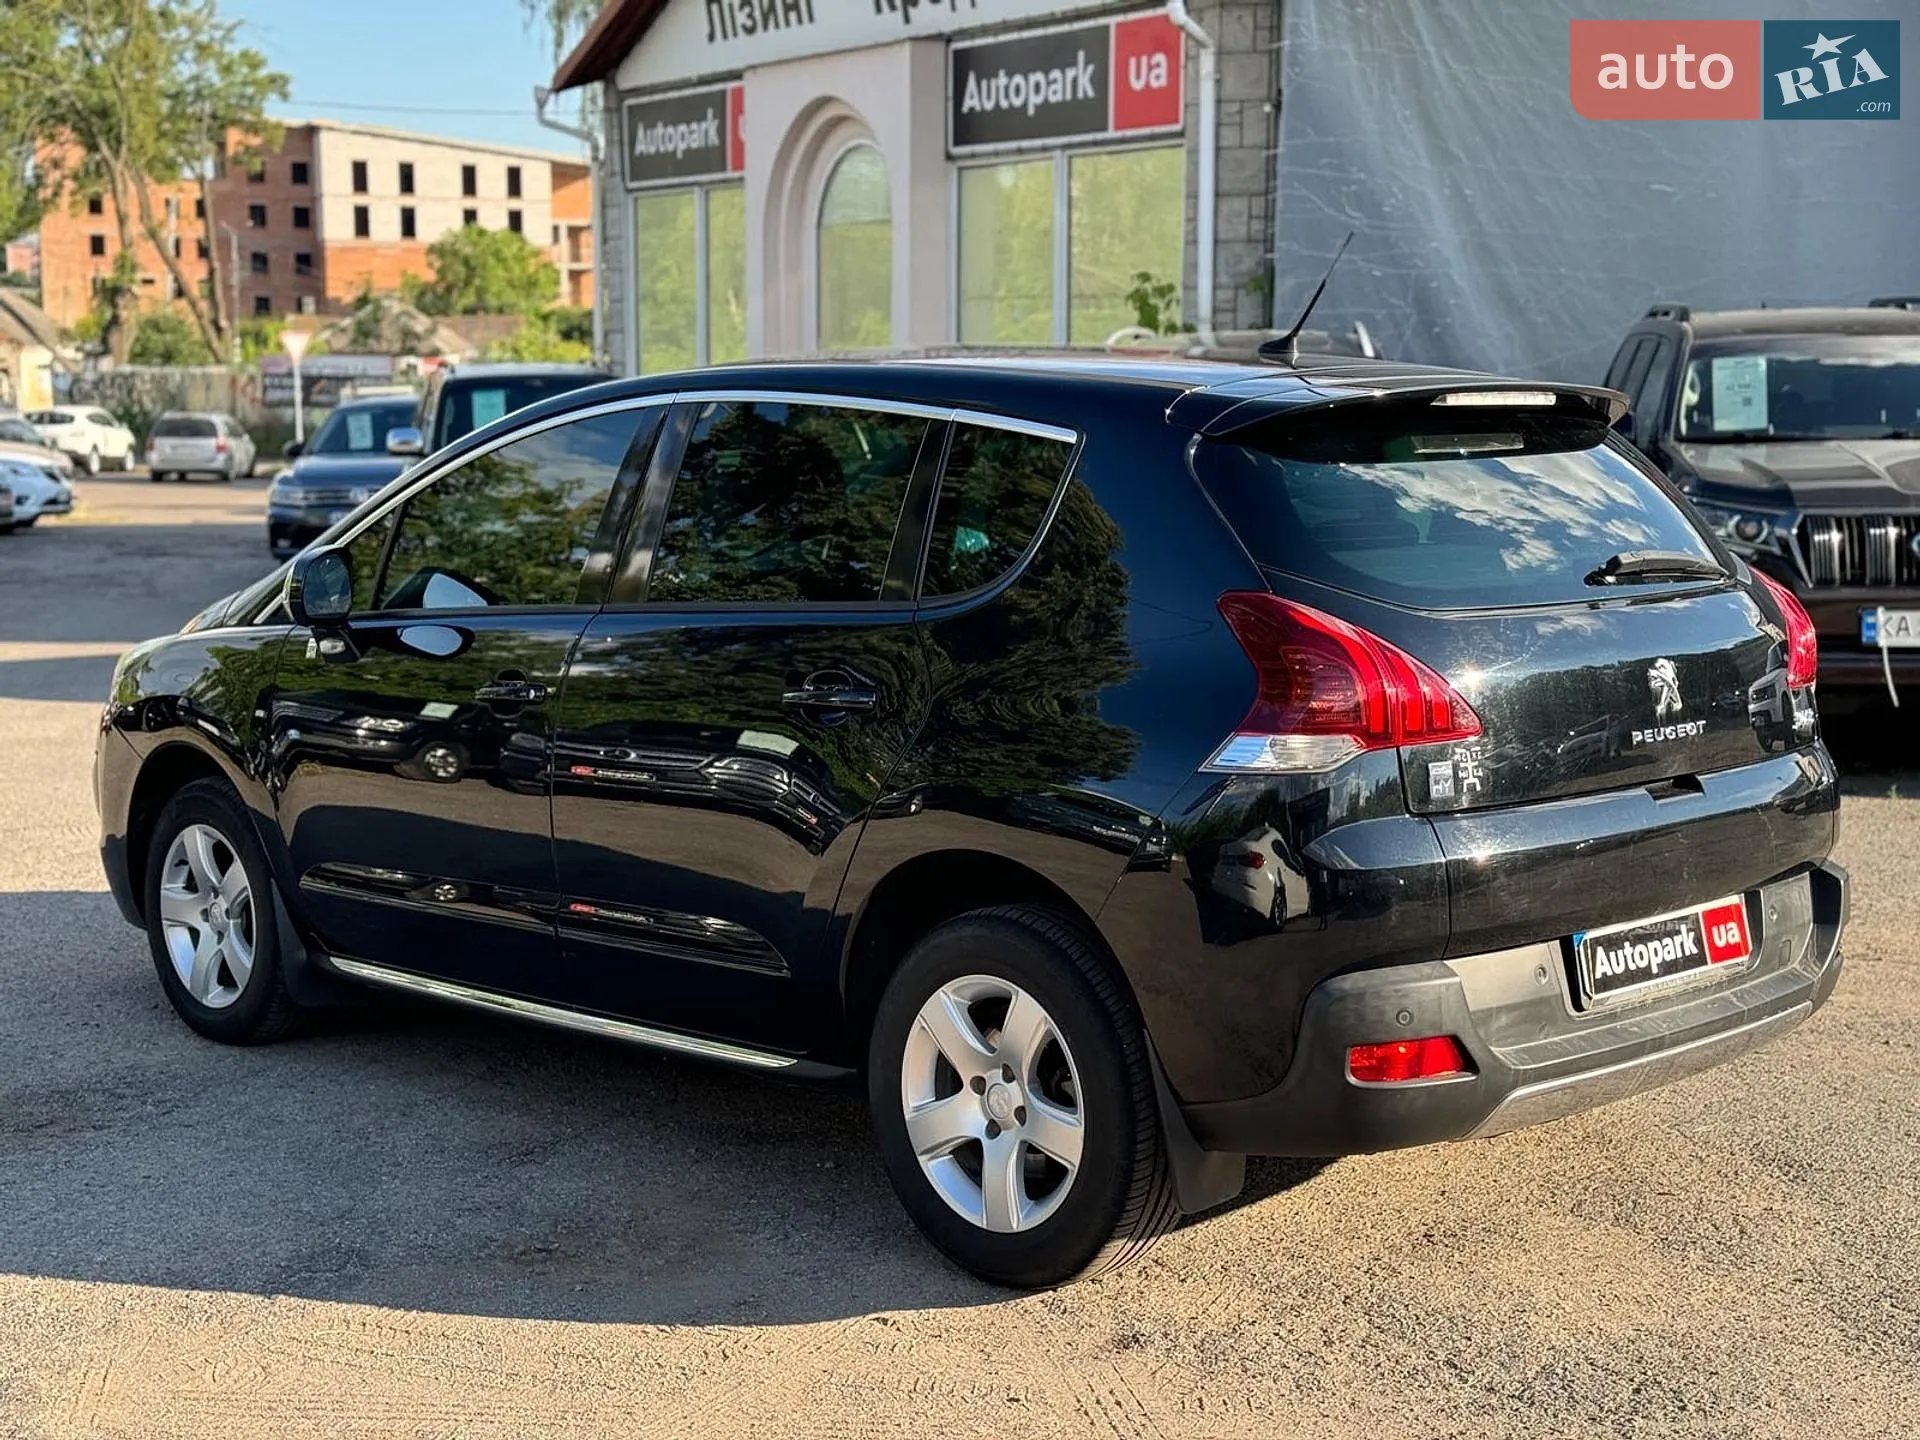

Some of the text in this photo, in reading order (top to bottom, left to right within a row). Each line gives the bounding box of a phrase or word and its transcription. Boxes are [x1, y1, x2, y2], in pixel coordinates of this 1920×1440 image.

[961, 49, 1168, 118] Autopark ua
[634, 106, 720, 160] Autopark
[1631, 720, 1707, 746] PEUGEOT
[1595, 920, 1742, 980] Autopark ua
